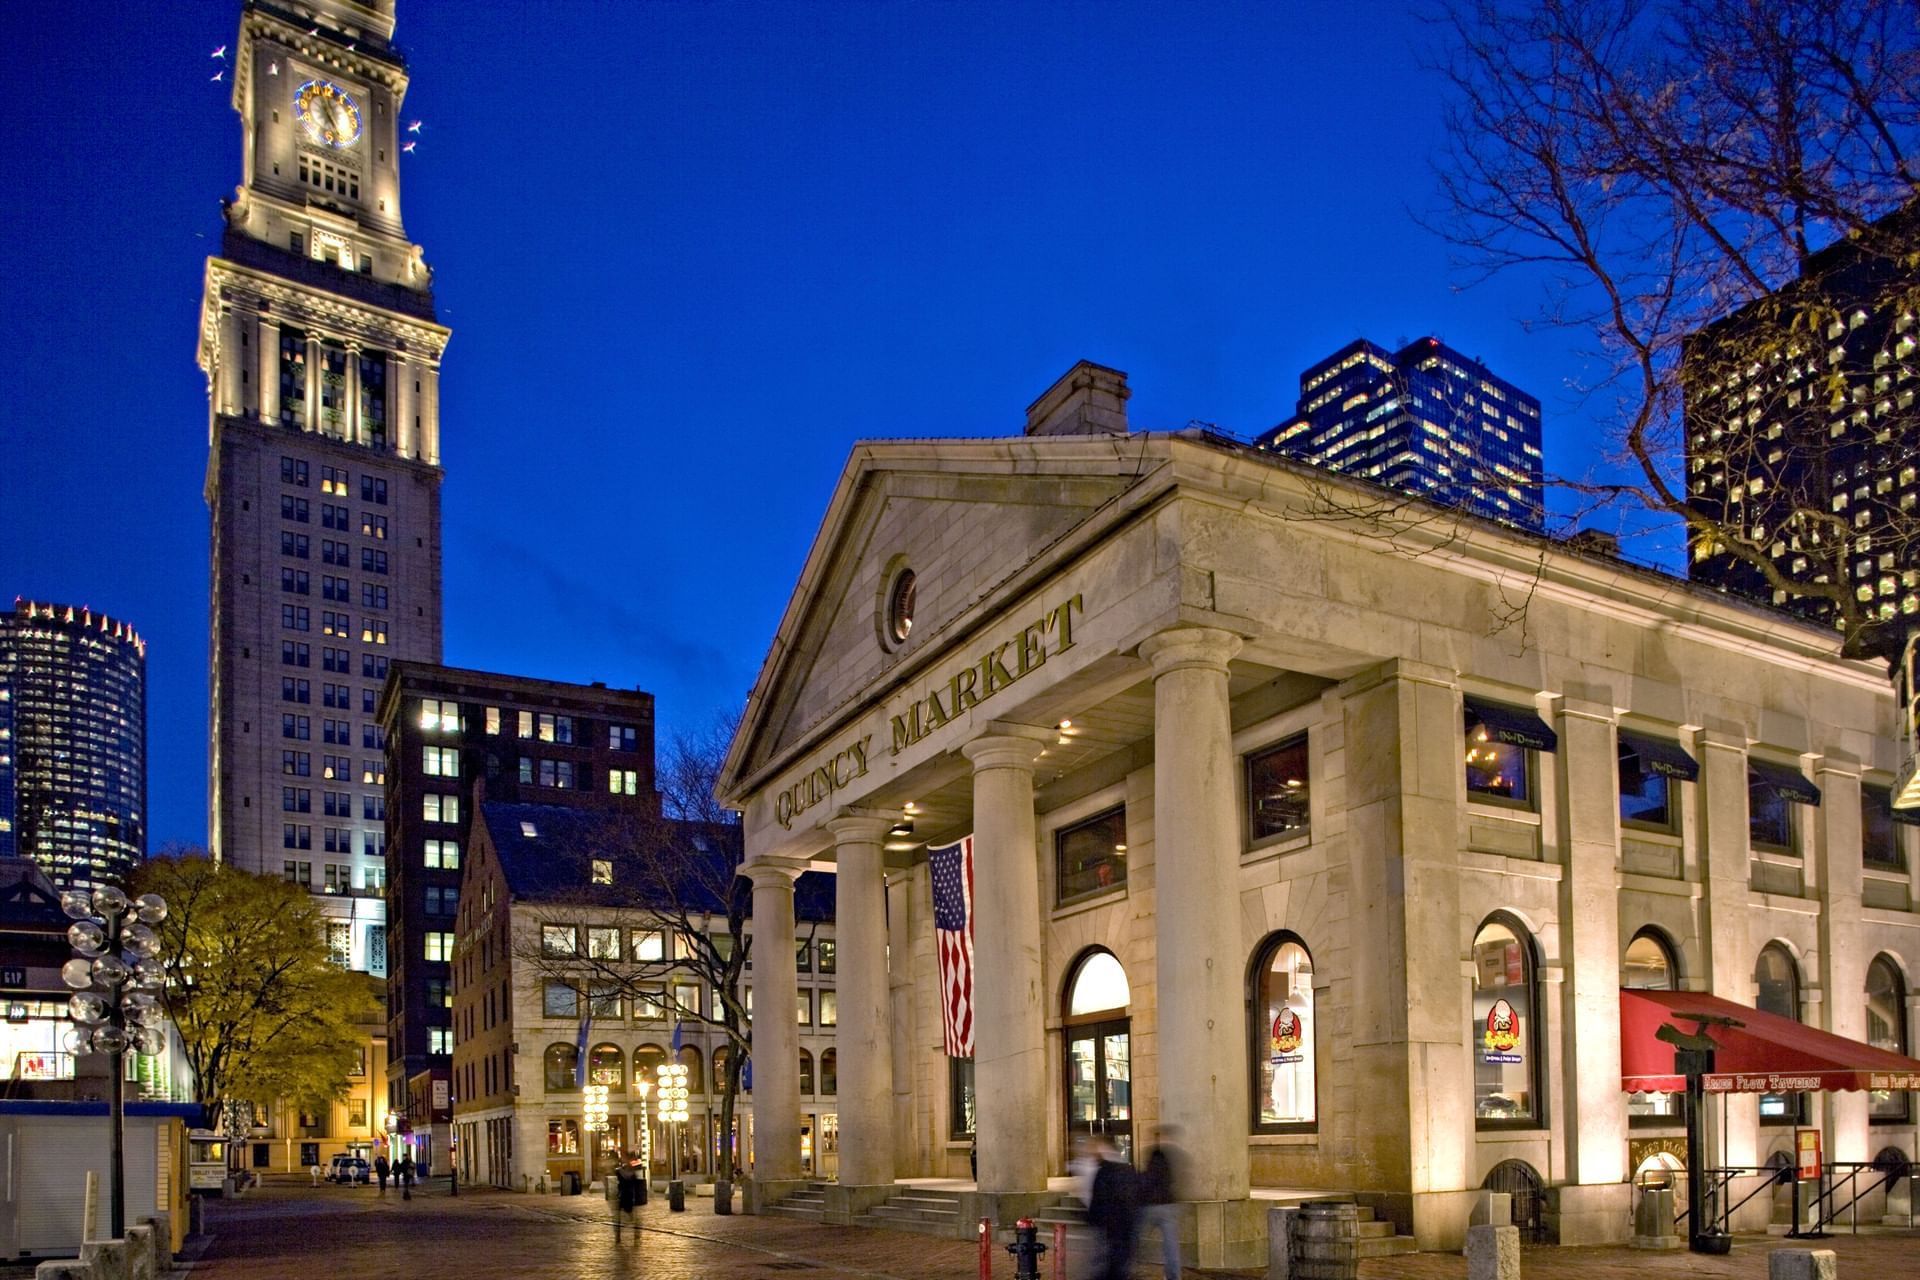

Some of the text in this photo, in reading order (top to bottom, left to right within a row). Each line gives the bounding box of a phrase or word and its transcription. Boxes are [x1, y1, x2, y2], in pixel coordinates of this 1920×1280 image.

[324, 87, 334, 97] 12
[776, 594, 1084, 831] QUINCY MARKET
[4, 972, 22, 984] GAP
[1736, 1075, 1767, 1089] PLOW
[1769, 1074, 1820, 1089] TAVERN
